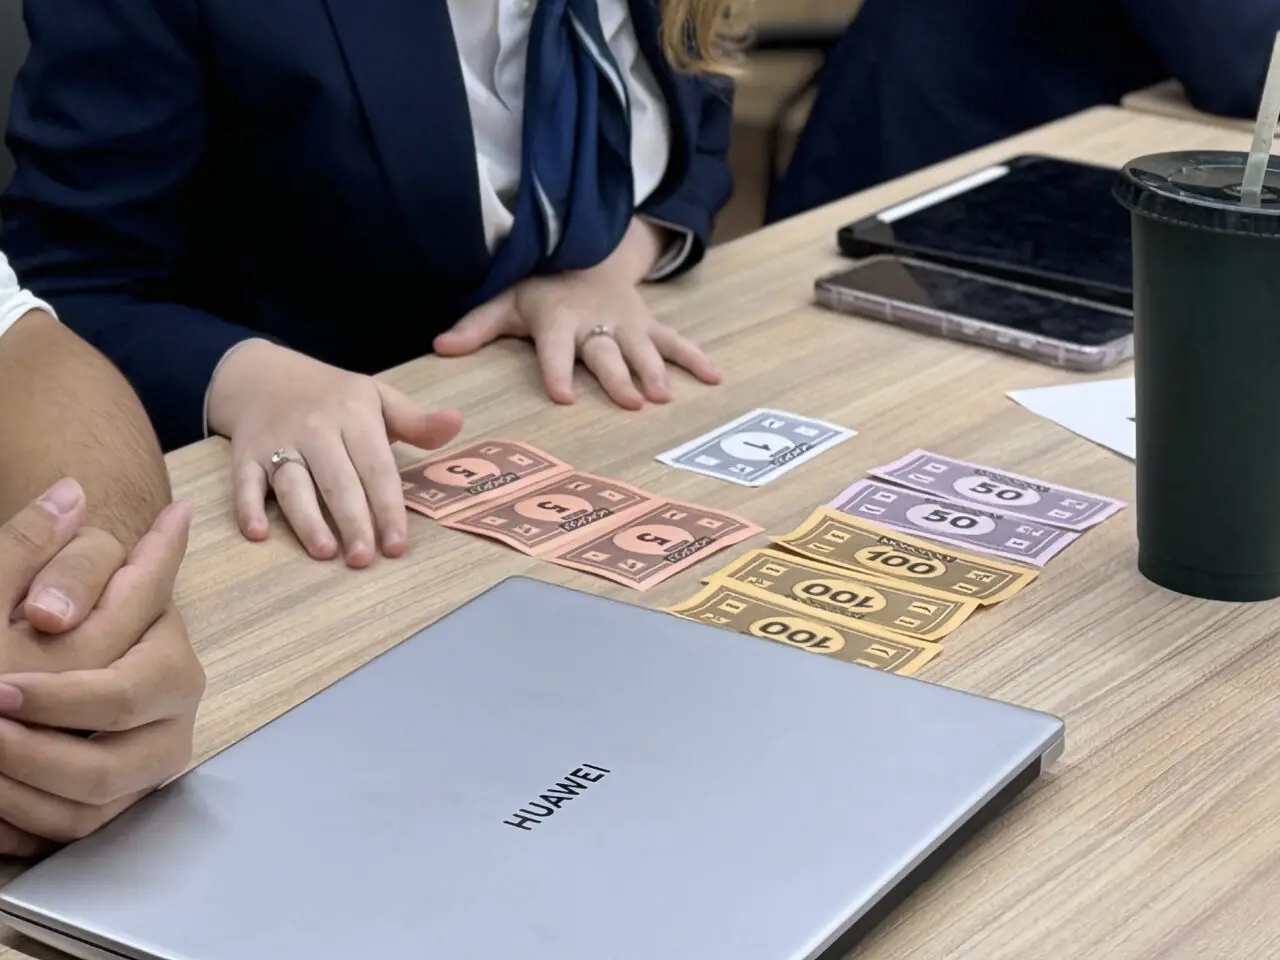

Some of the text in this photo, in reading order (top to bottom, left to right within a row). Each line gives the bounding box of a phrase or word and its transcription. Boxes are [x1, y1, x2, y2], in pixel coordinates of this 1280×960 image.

[446, 464, 478, 478] 5
[968, 482, 1024, 501] 50
[536, 501, 571, 514] 5
[921, 509, 979, 529] 50
[635, 532, 672, 546] 5
[865, 550, 937, 575] 100
[801, 583, 874, 608] 100
[758, 621, 834, 649] 100
[502, 763, 611, 831] HUAWEI
